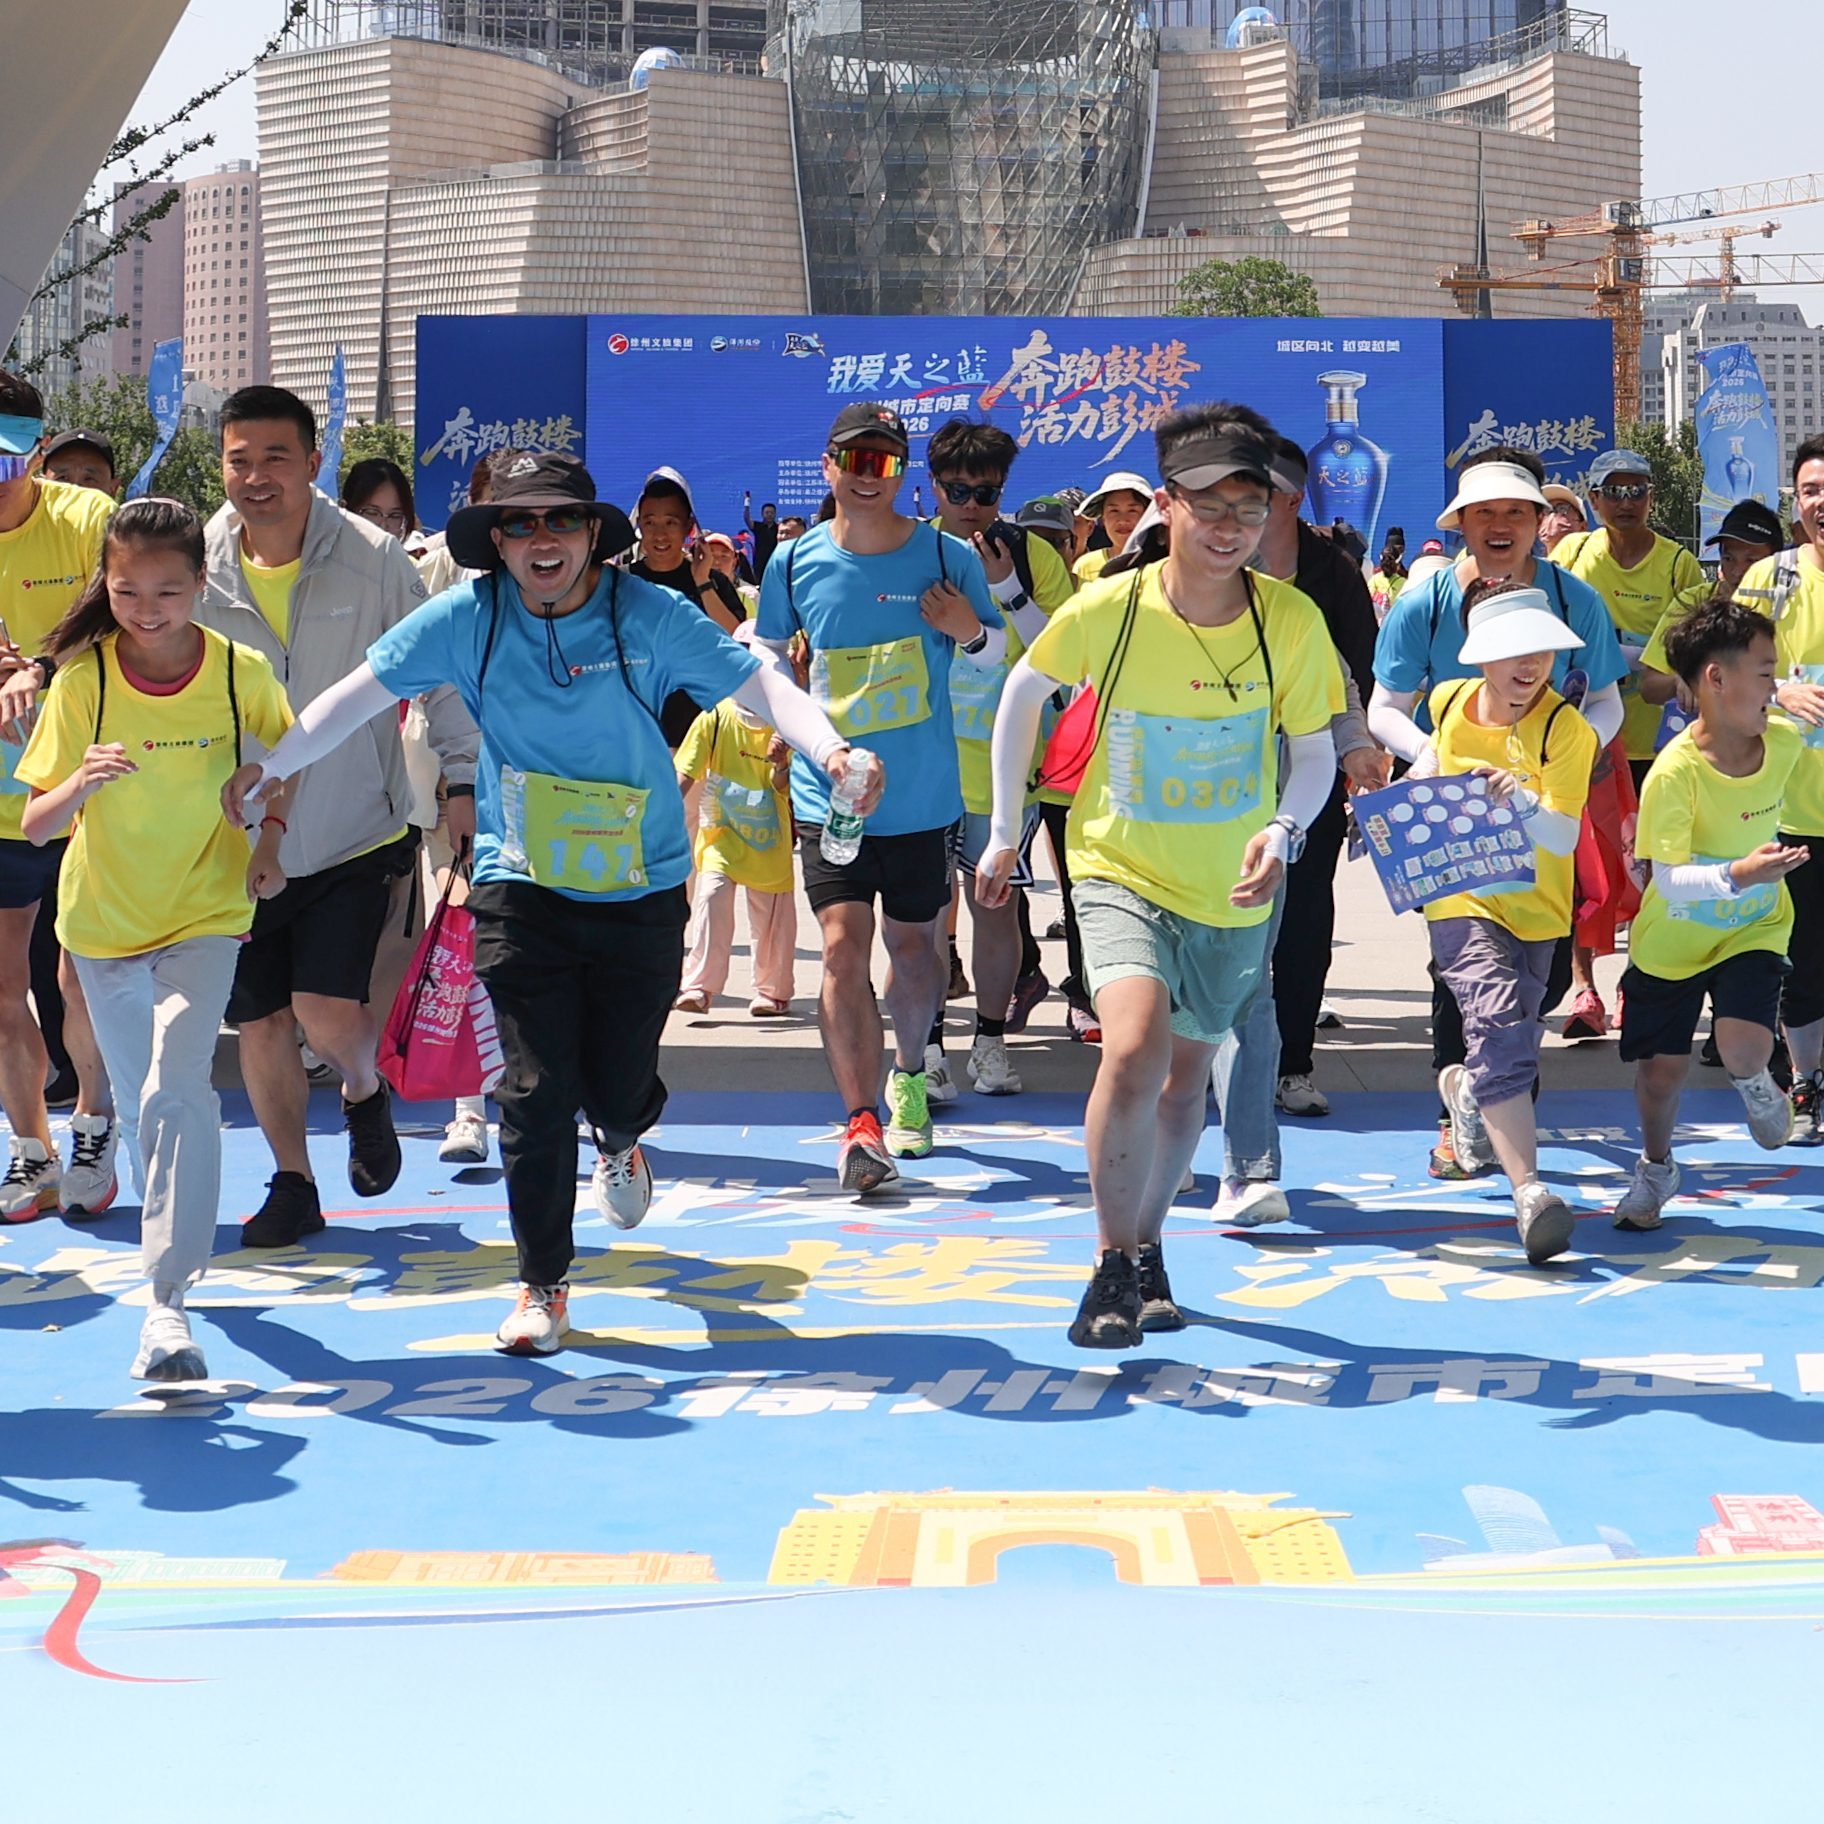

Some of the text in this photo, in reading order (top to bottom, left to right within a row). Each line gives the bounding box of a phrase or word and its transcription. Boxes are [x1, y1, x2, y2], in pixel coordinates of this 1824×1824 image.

[978, 329, 1201, 410] 奔跑鼓楼
[1277, 339, 1401, 353] 城区向北 越变越美
[848, 393, 970, 416] 城市定向赛
[419, 406, 583, 467] 奔跑鼓楼
[1445, 408, 1606, 470] 奔跑鼓楼
